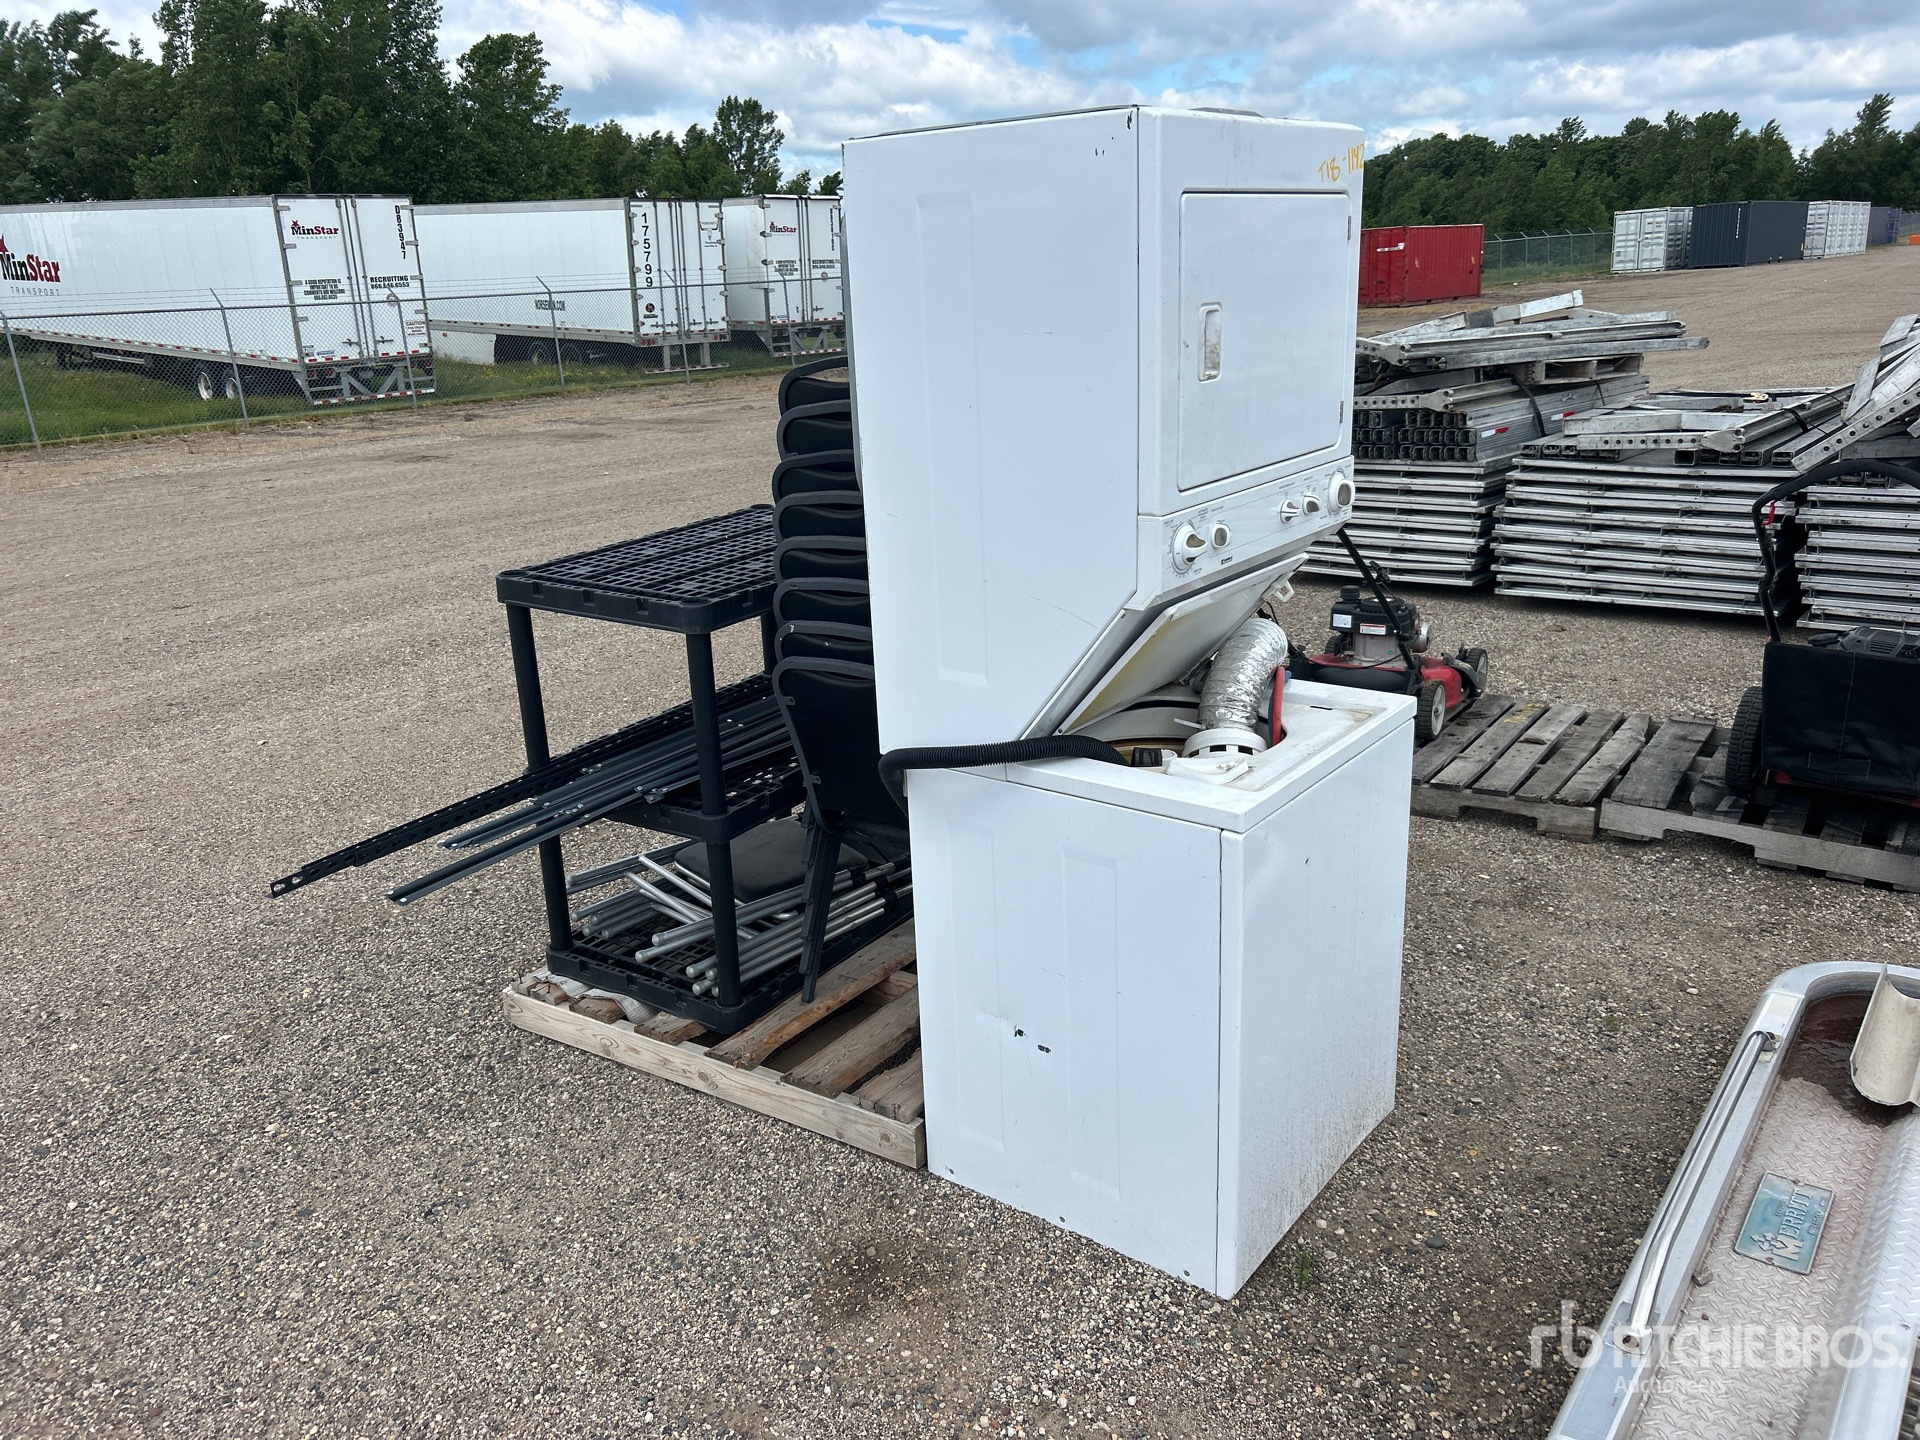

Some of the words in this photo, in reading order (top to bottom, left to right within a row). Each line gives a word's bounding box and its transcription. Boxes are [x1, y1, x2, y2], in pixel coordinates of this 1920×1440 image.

[291, 224, 339, 236] MinStar
[395, 205, 407, 259] D83947
[641, 212, 653, 287] 175799
[0, 253, 61, 283] MinStar
[370, 275, 409, 283] RECRUITING
[10, 286, 60, 297] TRANSPORT
[1772, 1187, 1812, 1261] MERRITT
